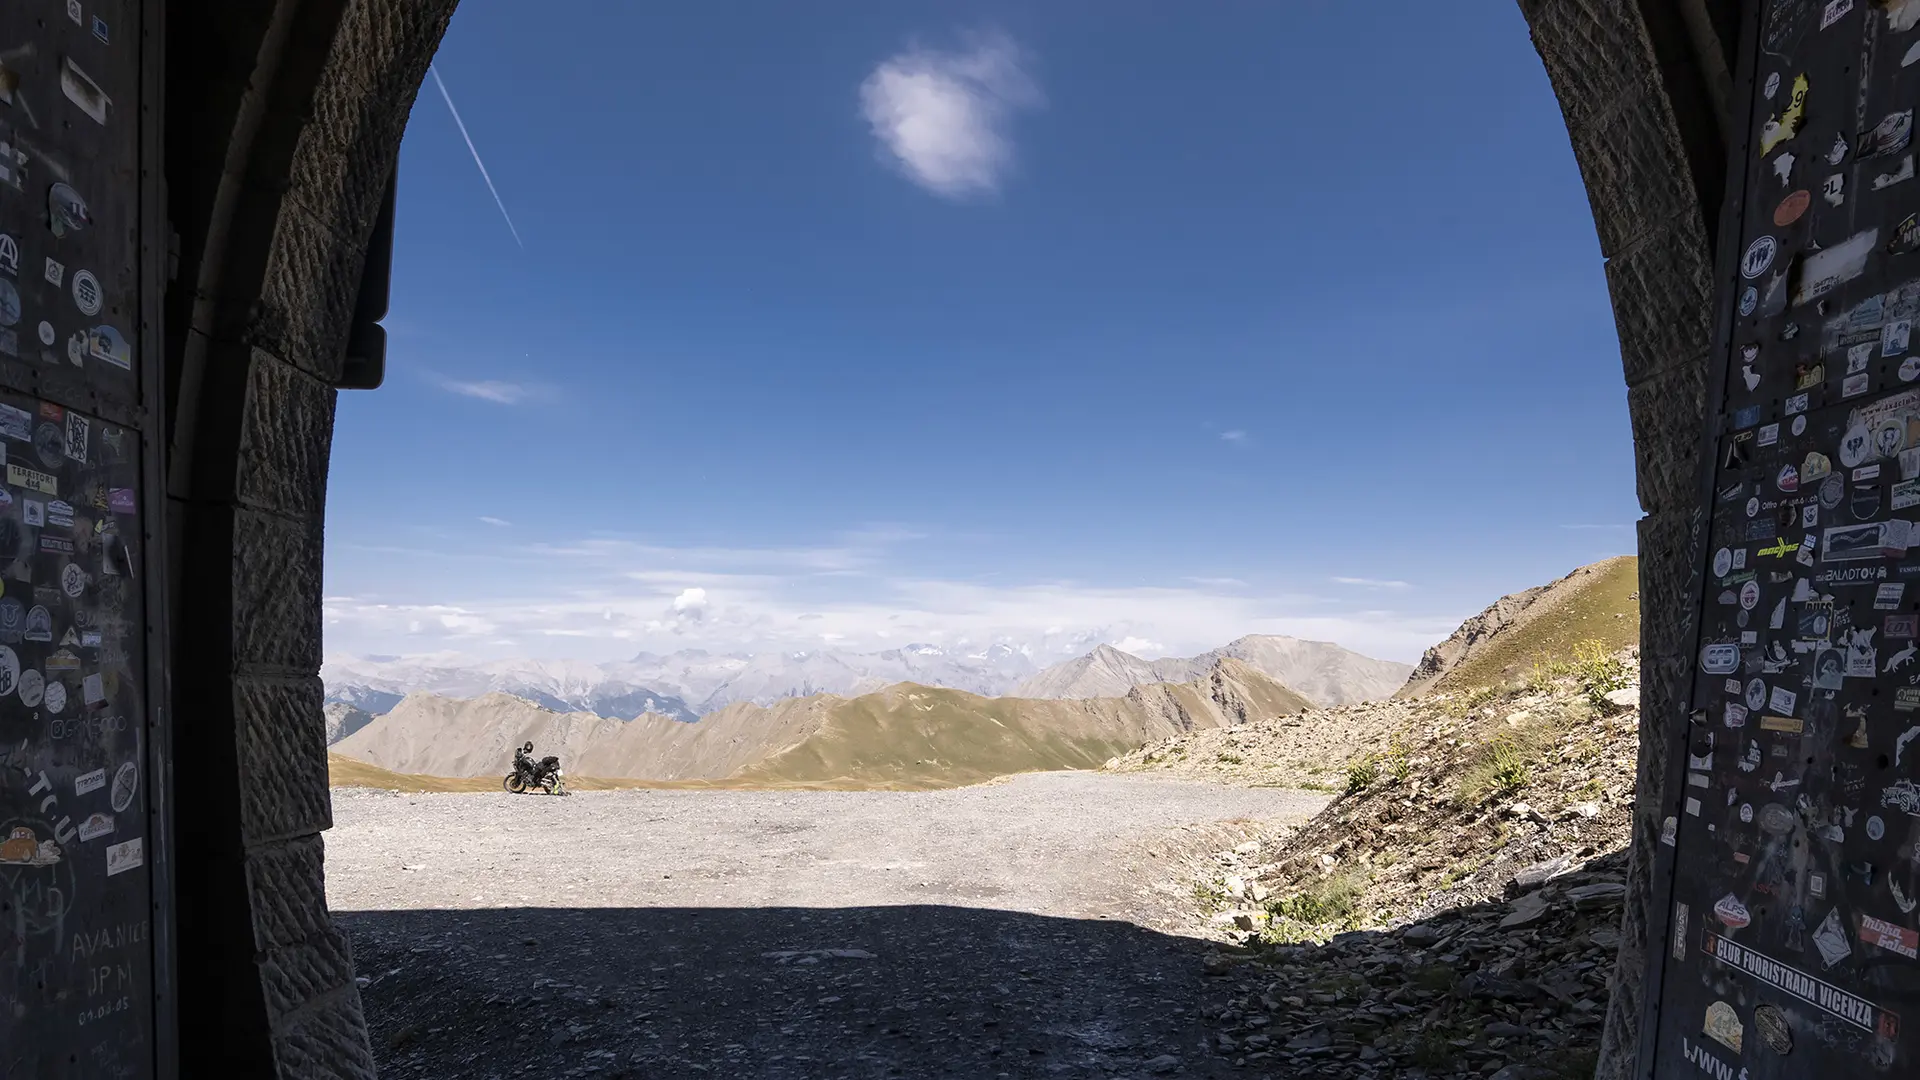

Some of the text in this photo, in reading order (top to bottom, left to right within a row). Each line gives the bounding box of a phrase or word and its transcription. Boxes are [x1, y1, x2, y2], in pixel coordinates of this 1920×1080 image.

[1718, 901, 1745, 915] ALPS
[1717, 939, 1872, 1028] CLUB FUORISTRADA VICENZA
